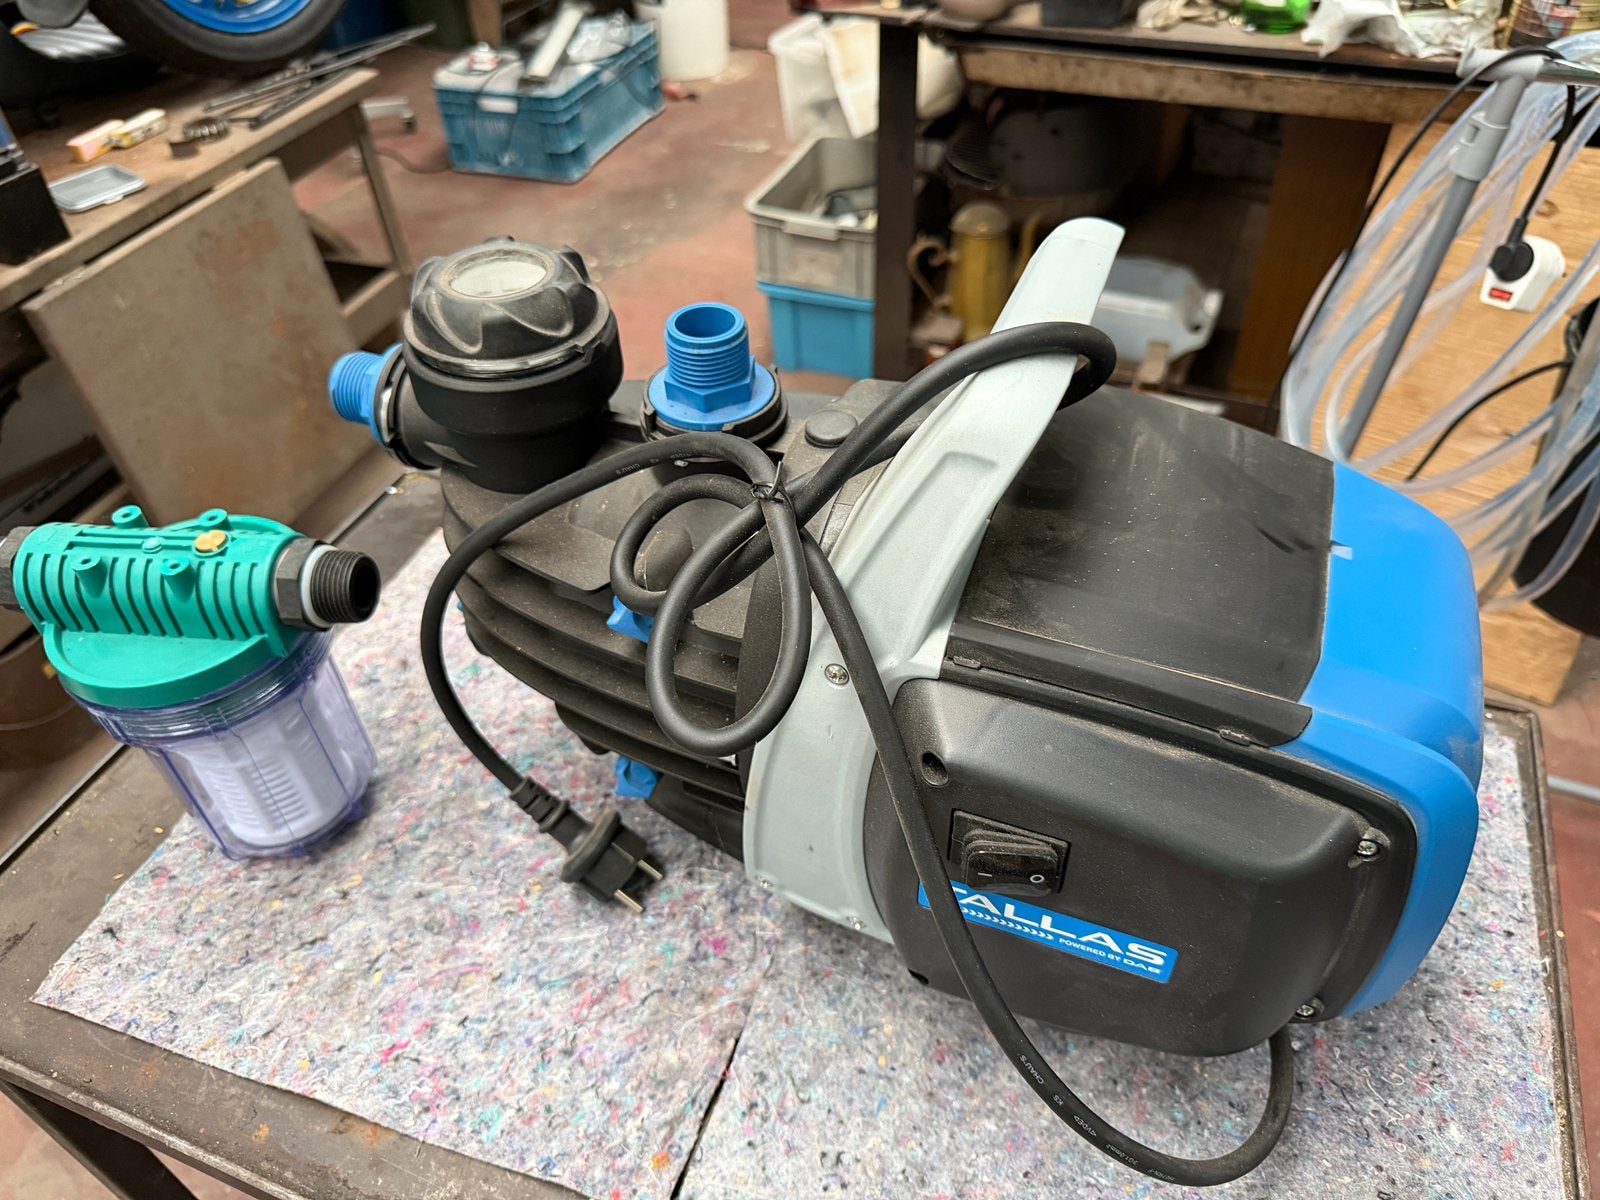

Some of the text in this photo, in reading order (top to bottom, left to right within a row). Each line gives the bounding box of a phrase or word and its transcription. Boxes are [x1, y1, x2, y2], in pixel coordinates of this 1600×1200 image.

[1059, 938, 1161, 975] POWERED BY DAB
